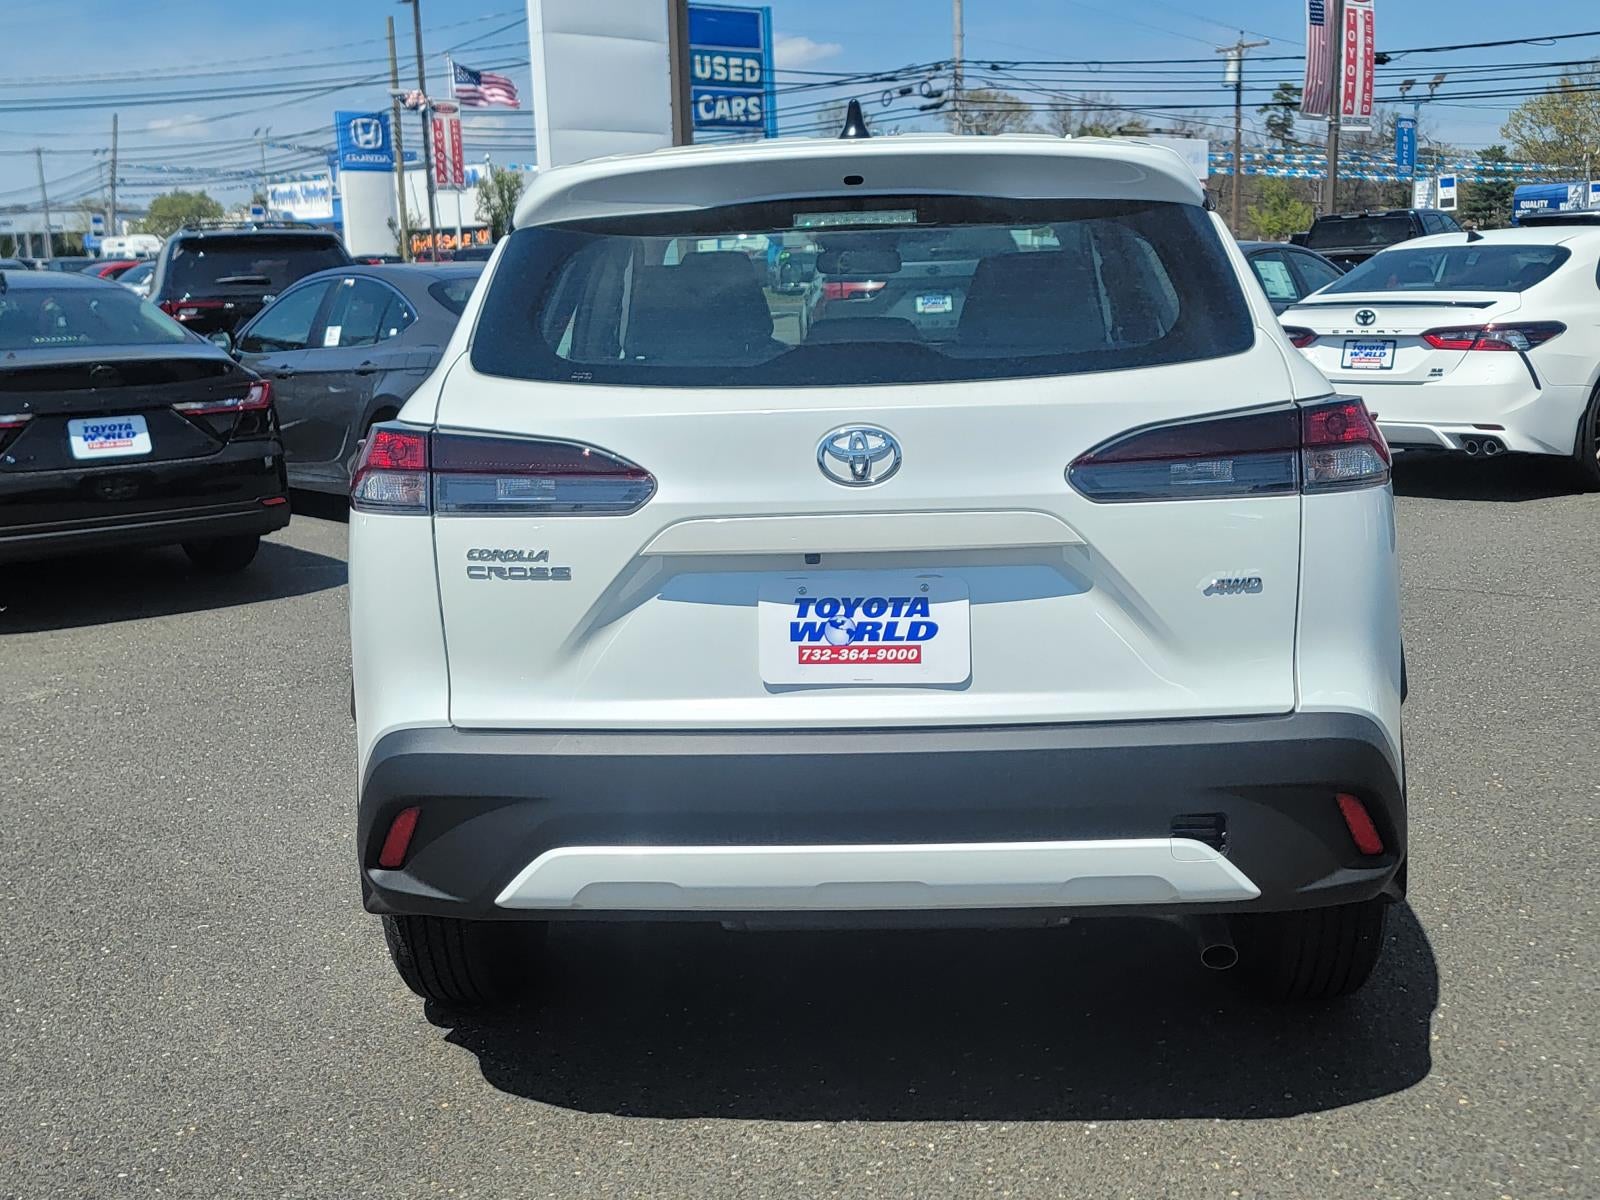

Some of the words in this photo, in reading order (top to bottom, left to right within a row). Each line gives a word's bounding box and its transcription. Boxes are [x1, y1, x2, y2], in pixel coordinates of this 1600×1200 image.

[694, 54, 761, 83] USED
[1344, 12, 1356, 110] TOYOTA
[1362, 13, 1372, 113] CERTIFIED
[698, 94, 761, 122] CARS
[1520, 200, 1548, 209] QUALITY
[83, 423, 133, 434] TOYOTA
[466, 549, 549, 562] COROLLA
[466, 566, 572, 580] CROSS
[1203, 577, 1264, 596] AWD
[794, 596, 931, 618] TOYOTA
[801, 648, 918, 661] 732-364-9000
